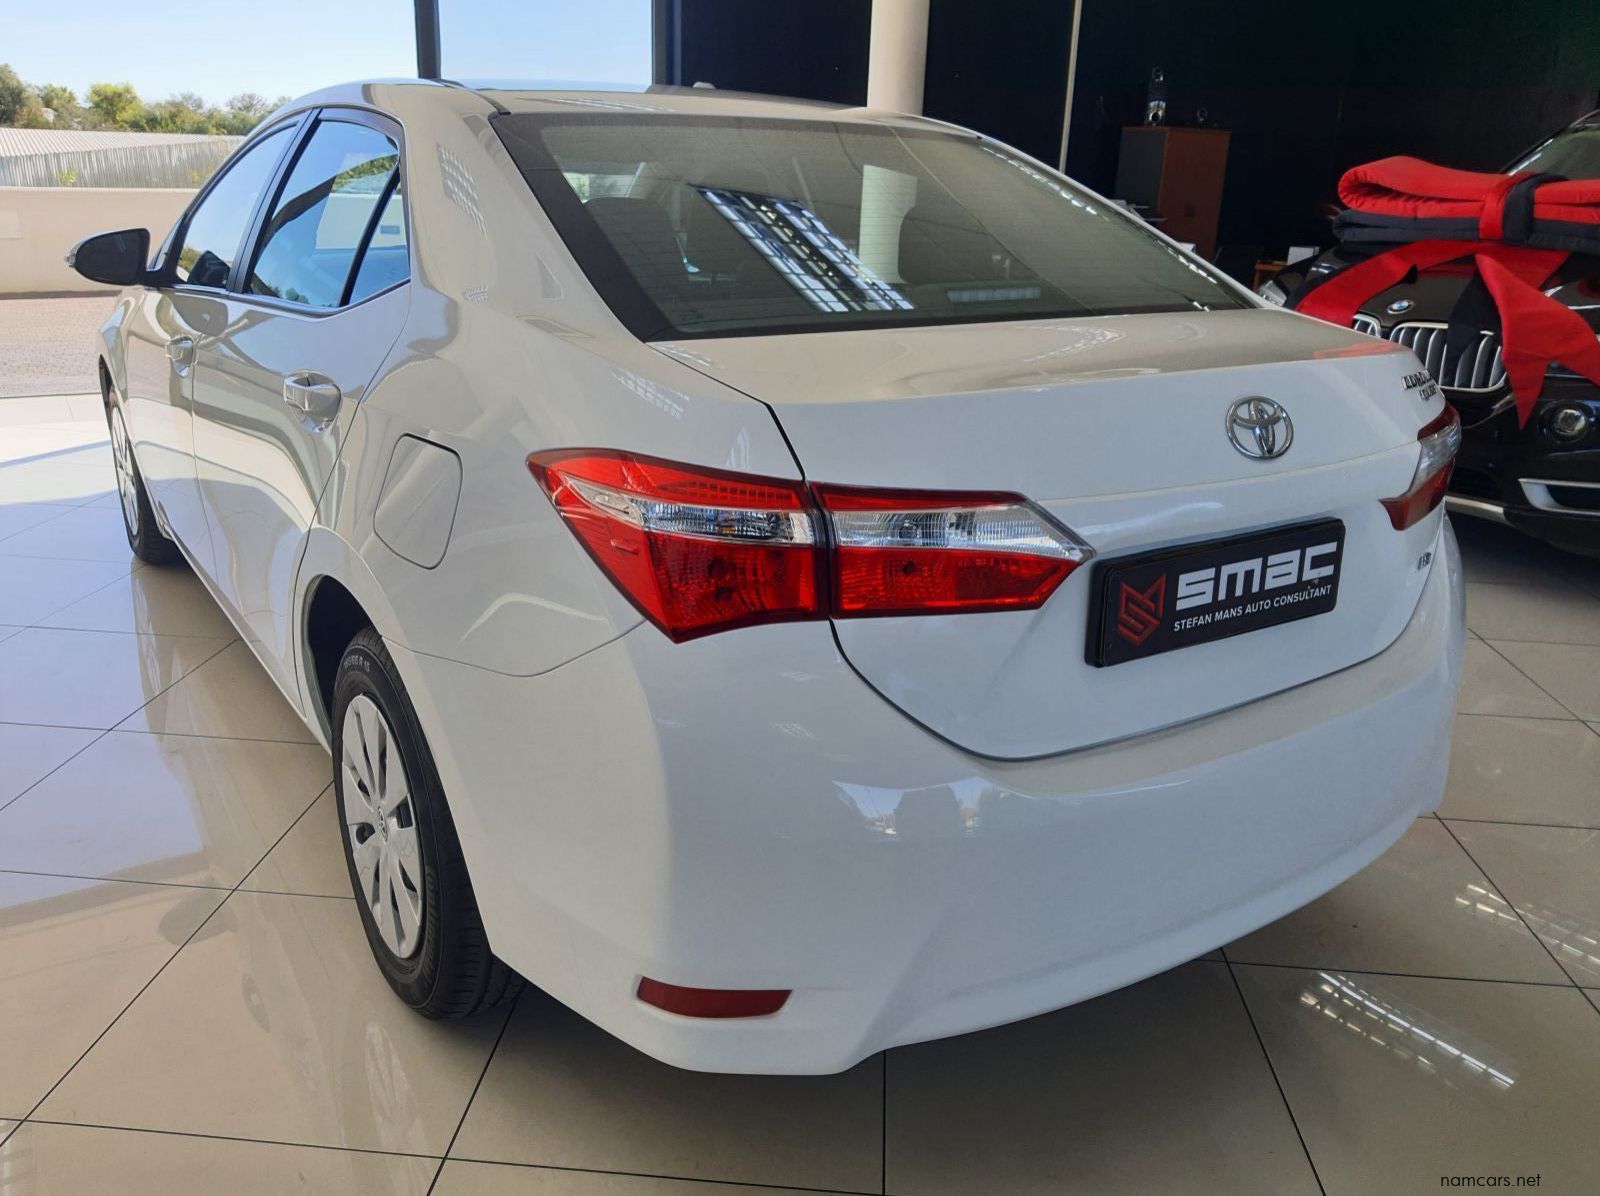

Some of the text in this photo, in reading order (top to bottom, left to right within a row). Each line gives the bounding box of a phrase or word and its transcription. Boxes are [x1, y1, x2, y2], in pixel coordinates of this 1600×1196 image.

[1173, 584, 1332, 632] STEFAN MANS AUTO CONSULTANT
